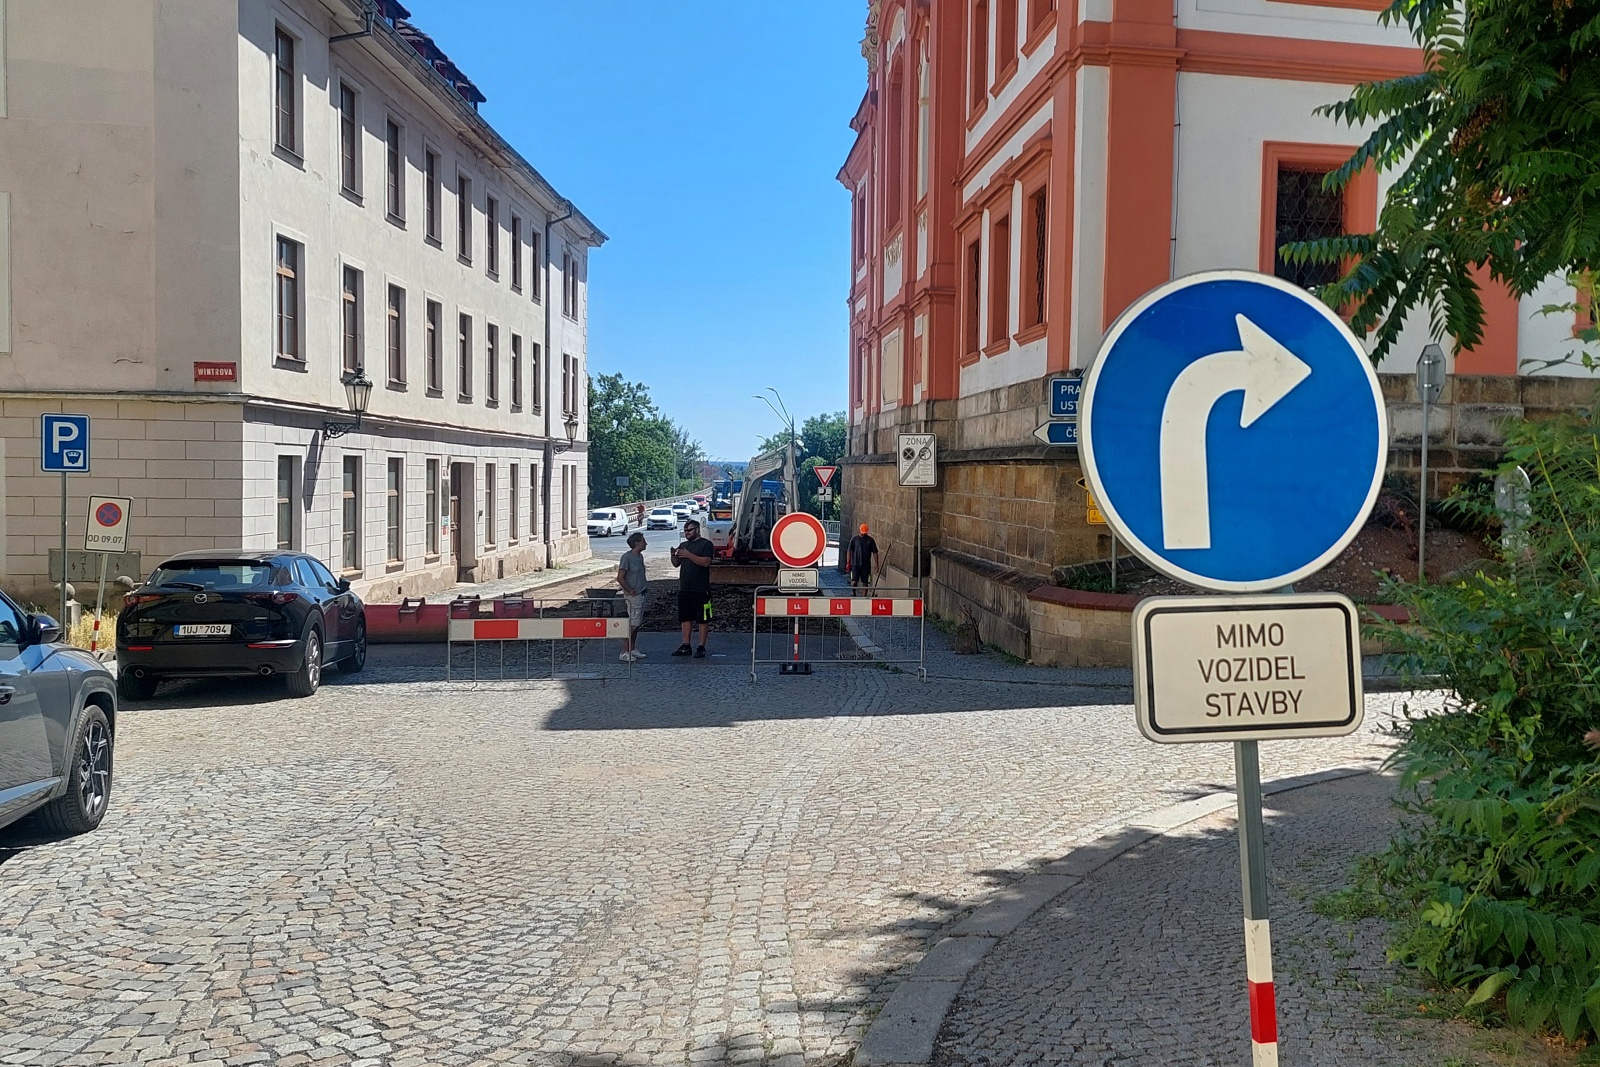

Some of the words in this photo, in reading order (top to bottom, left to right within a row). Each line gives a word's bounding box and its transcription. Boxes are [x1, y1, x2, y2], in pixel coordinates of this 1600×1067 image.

[197, 368, 233, 376] WINTROVA
[53, 421, 79, 454] P
[87, 534, 100, 543] OD
[101, 535, 124, 545] 09.07.
[182, 625, 198, 634] 1UJ
[204, 625, 227, 634] 7094
[1216, 622, 1284, 648] MIMO
[1197, 656, 1306, 683] VOZIDEL
[1205, 689, 1303, 717] STAVBY
